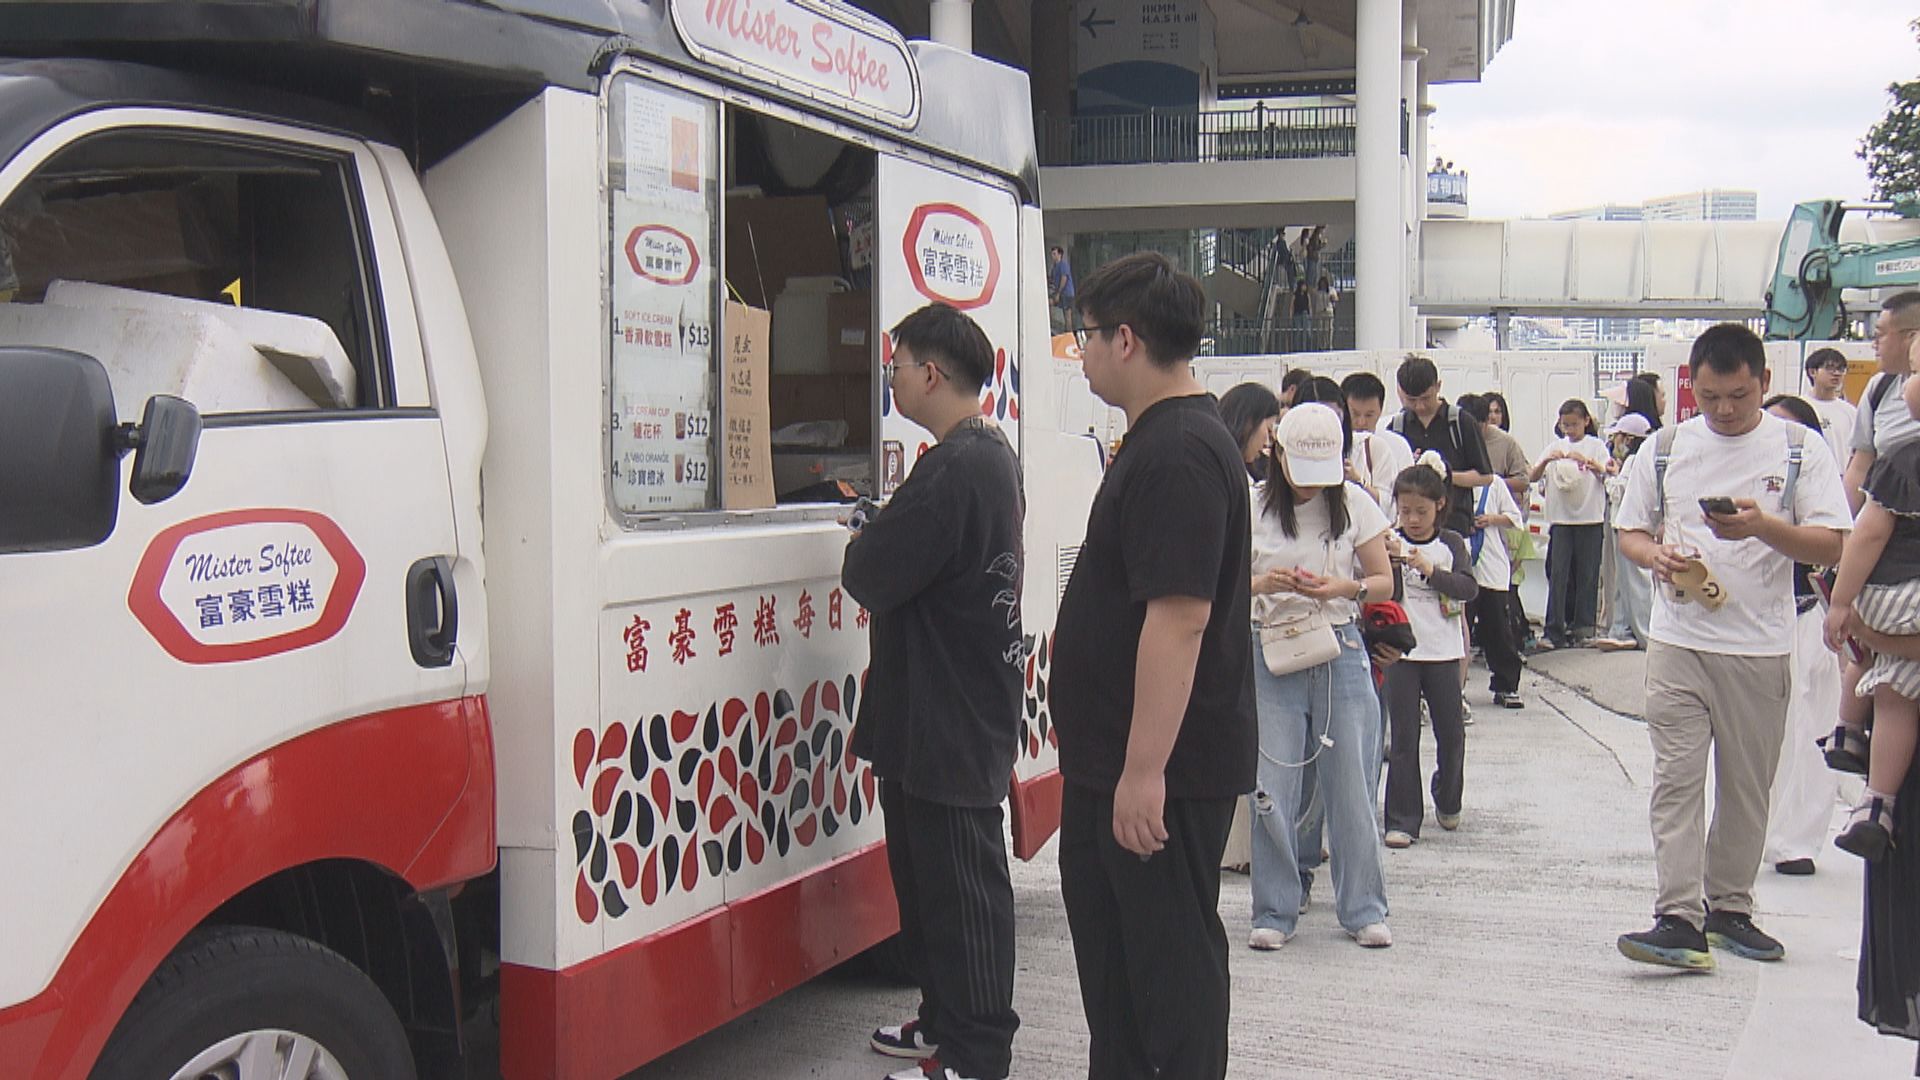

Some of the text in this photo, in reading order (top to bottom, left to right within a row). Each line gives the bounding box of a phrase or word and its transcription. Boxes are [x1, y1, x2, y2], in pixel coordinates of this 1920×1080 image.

[705, 0, 889, 97] Mister Softee
[923, 246, 983, 287] 富豪雪糕
[689, 321, 710, 348] $13
[687, 412, 708, 439] $12
[686, 456, 707, 483] $12
[185, 541, 312, 582] Mister Softee
[195, 578, 315, 629] 富豪雪糕
